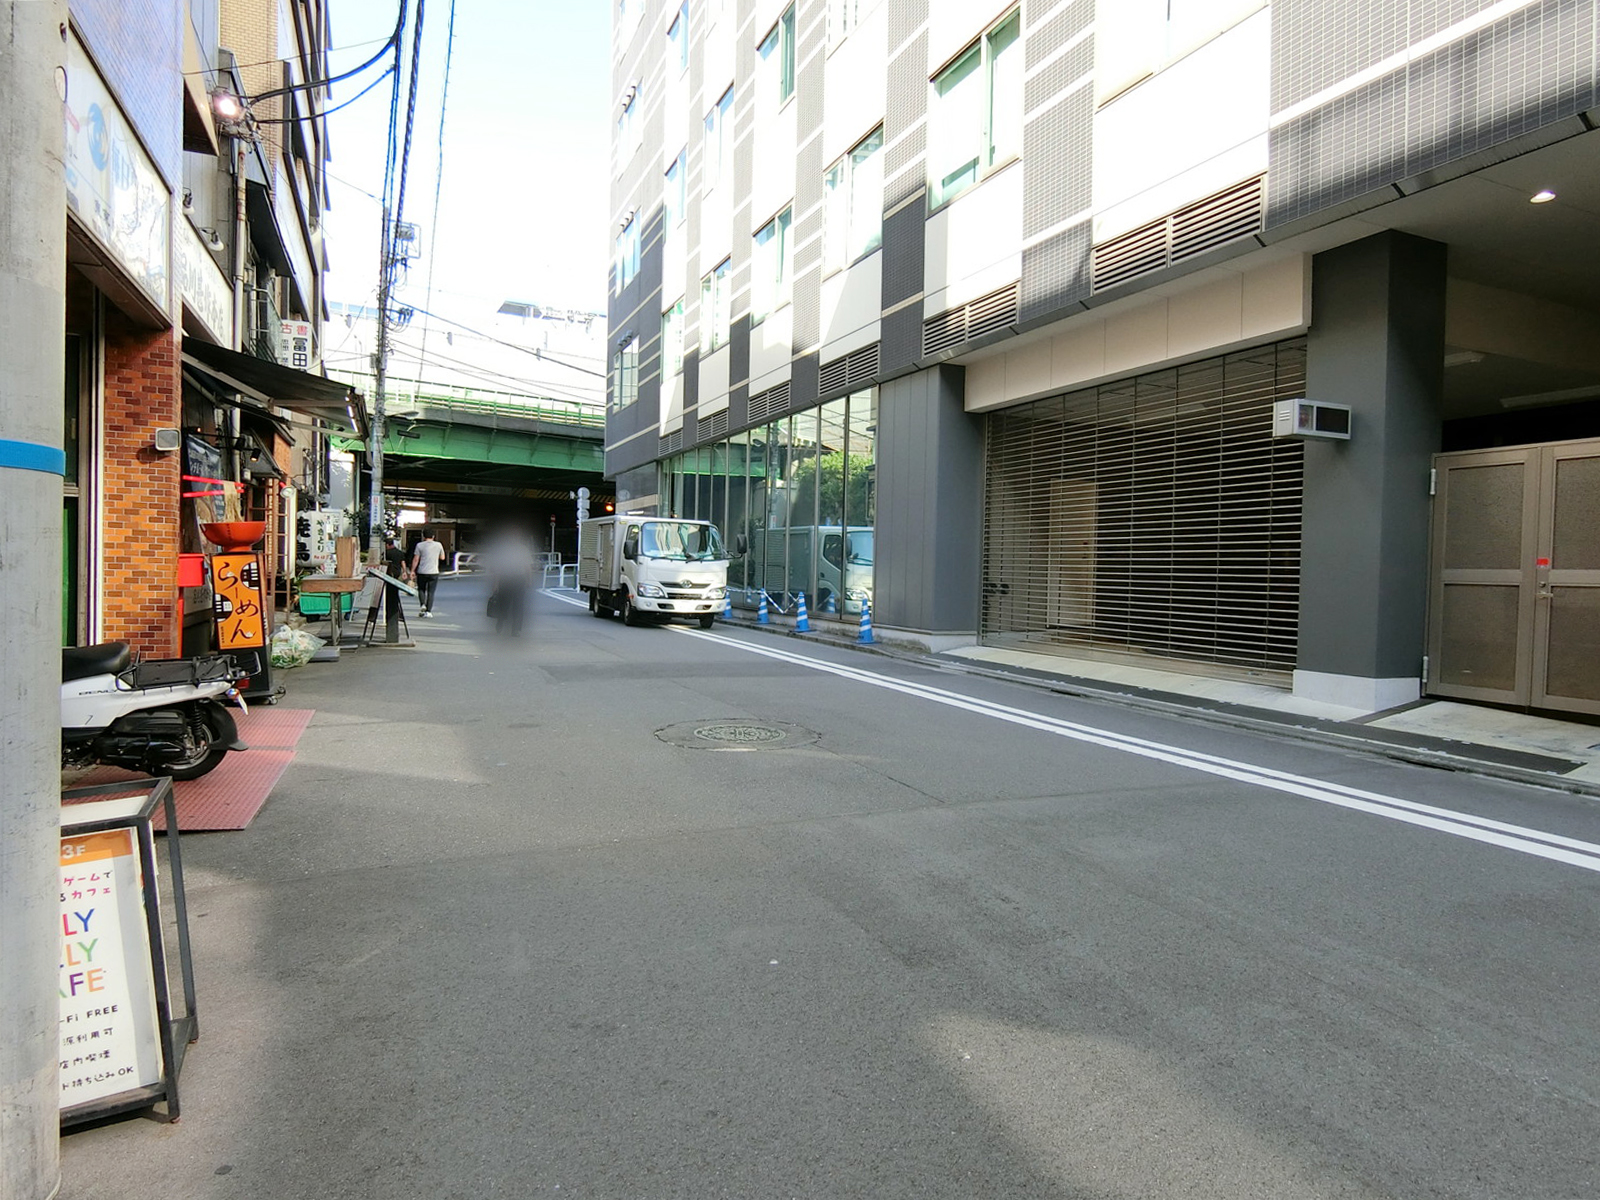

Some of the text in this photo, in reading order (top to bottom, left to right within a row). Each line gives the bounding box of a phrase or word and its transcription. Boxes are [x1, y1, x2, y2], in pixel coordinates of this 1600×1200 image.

[281, 323, 308, 336] 古書
[316, 519, 325, 552] やきとり
[217, 561, 259, 643] らーめん
[61, 844, 86, 859] 3F
[63, 869, 114, 887] ゲームで
[60, 938, 98, 968] LY
[86, 1004, 118, 1018] FREE
